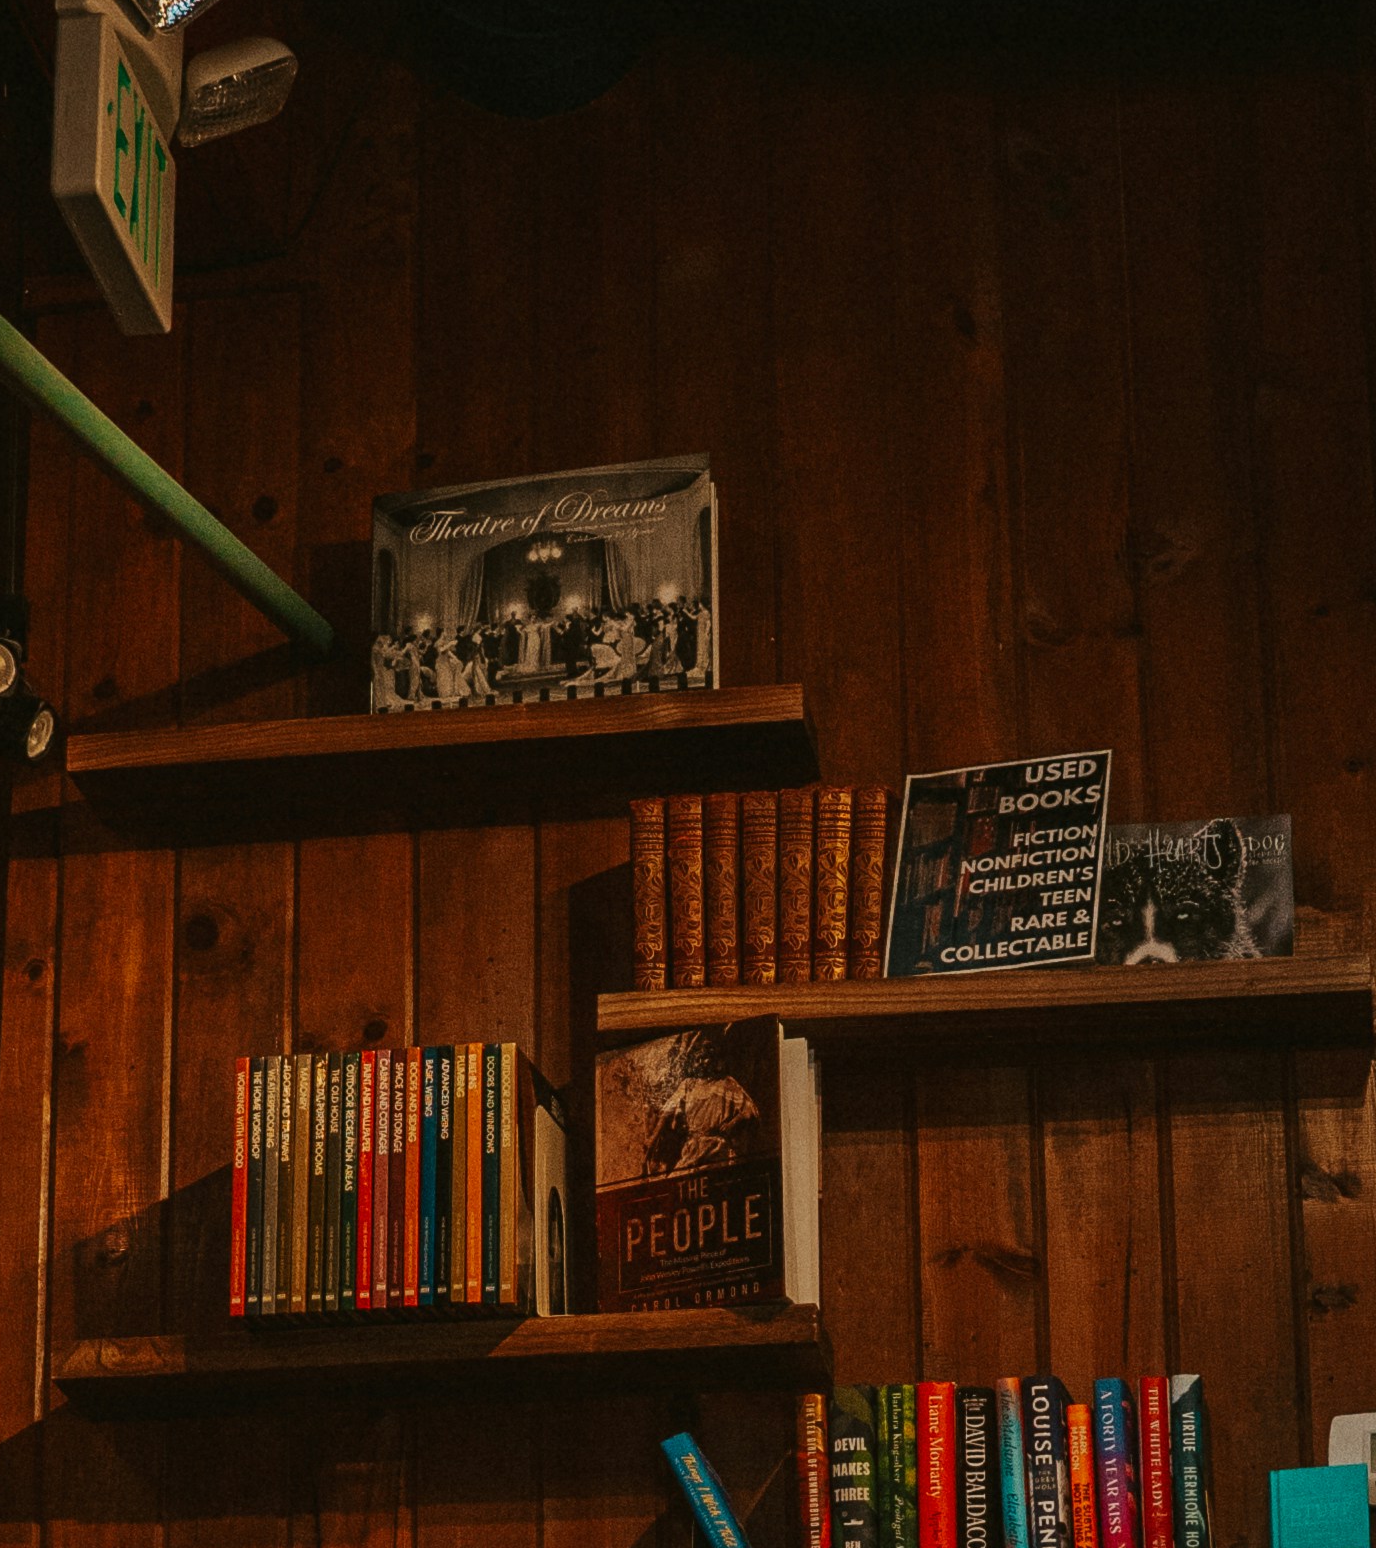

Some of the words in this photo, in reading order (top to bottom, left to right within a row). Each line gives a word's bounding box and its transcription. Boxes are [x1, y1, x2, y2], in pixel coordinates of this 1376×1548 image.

[114, 58, 166, 289] EXIT
[410, 508, 515, 544] Theatre
[522, 503, 550, 536] of
[554, 489, 667, 522] Dreams
[1025, 759, 1097, 784] USED
[998, 784, 1102, 815] BOOKS
[1013, 825, 1098, 848] FICTION
[961, 847, 1096, 874] NONFICTION
[969, 866, 1094, 894] CHILDREN'S
[1040, 887, 1092, 906] TEEN
[1010, 911, 1067, 932] RARE
[1073, 908, 1090, 924] &
[939, 933, 1089, 963] COLLECTABLE
[253, 1071, 261, 1084] THE
[346, 1064, 354, 1107] OUTDOOR
[363, 1063, 371, 1084] PAINT
[380, 1058, 388, 1090] CABINS
[395, 1062, 403, 1089] SPACE
[456, 1055, 465, 1098] PLUMBING
[237, 1072, 245, 1114] WORKING
[253, 1086, 261, 1110] HOME
[395, 1091, 403, 1110] AND
[252, 1112, 260, 1159] WORKSHOP
[346, 1110, 354, 1161] RECREATION
[362, 1107, 370, 1152] WALLPAPER
[379, 1111, 387, 1155] COTTAGES
[394, 1113, 402, 1153] STORAGE
[345, 1164, 353, 1191] AREAS
[677, 1176, 709, 1200] THE
[626, 1194, 762, 1262] PEOPLE
[806, 1403, 815, 1417] THE
[1100, 1390, 1112, 1400] A
[1148, 1387, 1159, 1415] THE
[807, 1421, 815, 1435] TEA
[928, 1395, 943, 1433] Liane
[1031, 1385, 1053, 1465] LOUISE
[1102, 1405, 1115, 1452] FORTY
[807, 1438, 816, 1455] GIRL
[834, 1437, 866, 1451] DEVIL
[965, 1415, 985, 1467] DAVID
[1079, 1426, 1087, 1454] MARK
[1150, 1420, 1161, 1466] WHITE
[1182, 1412, 1195, 1452] VIRTUE
[808, 1459, 817, 1468] OF
[1070, 1427, 1080, 1470] MANSON
[832, 1462, 870, 1476] MAKES
[926, 1437, 944, 1498] Moriarty
[1104, 1458, 1117, 1497] YEAR
[809, 1472, 819, 1527] HUMMINGBIRD
[834, 1488, 870, 1502] THREE
[1082, 1483, 1090, 1501] THE
[1151, 1471, 1163, 1509] LADY
[1184, 1466, 1198, 1526] HERMIONE
[1083, 1505, 1091, 1542] SUBTLE
[1107, 1503, 1121, 1534] KISS
[811, 1530, 820, 1548] LANE
